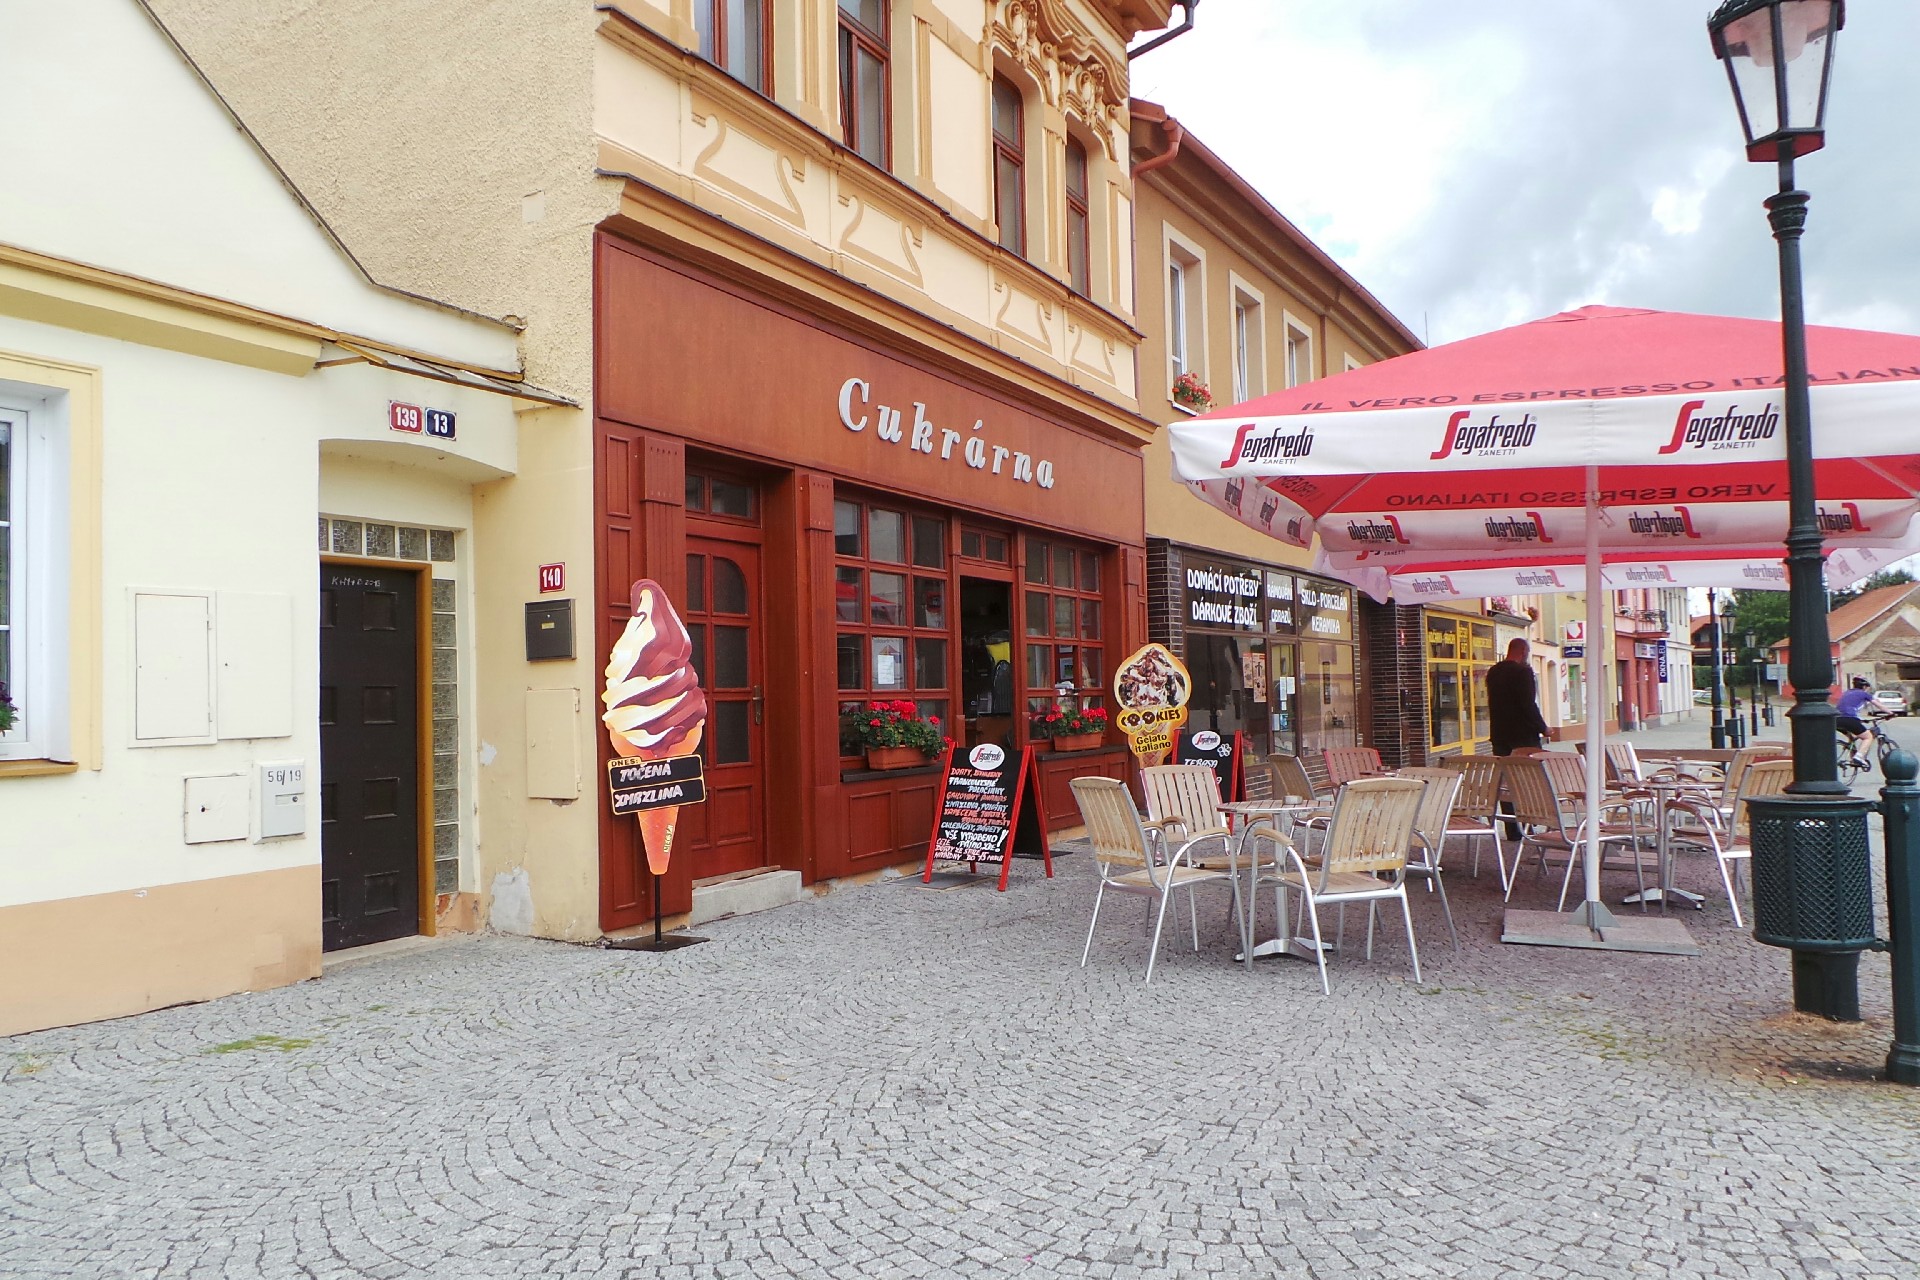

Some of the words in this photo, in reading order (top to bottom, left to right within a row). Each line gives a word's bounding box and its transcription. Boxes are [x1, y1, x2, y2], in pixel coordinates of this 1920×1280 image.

[1301, 402, 1332, 411] IL
[1348, 395, 1458, 408] VERO
[1472, 381, 1715, 403] ESPRESSO
[395, 406, 418, 429] 139
[433, 413, 448, 434] 13
[1658, 400, 1779, 455] Segafredo
[838, 377, 1055, 489] Cukrárna
[1430, 410, 1537, 460] Segafredo
[1220, 423, 1314, 469] Segafredo
[1478, 449, 1516, 457] ZANETTI
[1712, 441, 1756, 450] ZANETTI
[542, 567, 561, 588] 140
[1187, 566, 1222, 591] DOMÁCÍ
[1223, 573, 1259, 598] POTŘEBY
[1301, 588, 1316, 607] SKLO
[1320, 591, 1348, 612] PORCELÁN
[1192, 599, 1232, 624] DÁRKOVÉ
[1234, 603, 1257, 626] ZBOŽÍ
[1311, 615, 1341, 634] KERAMIKA
[1659, 645, 1667, 678] OKNA.EU
[1120, 709, 1181, 728] COOKIES
[1134, 741, 1171, 753] italiano
[1136, 734, 1168, 745] Gelato
[611, 758, 639, 767] DNES:
[620, 759, 672, 782] TOČENÁ
[615, 785, 684, 808] ZMRZLINA
